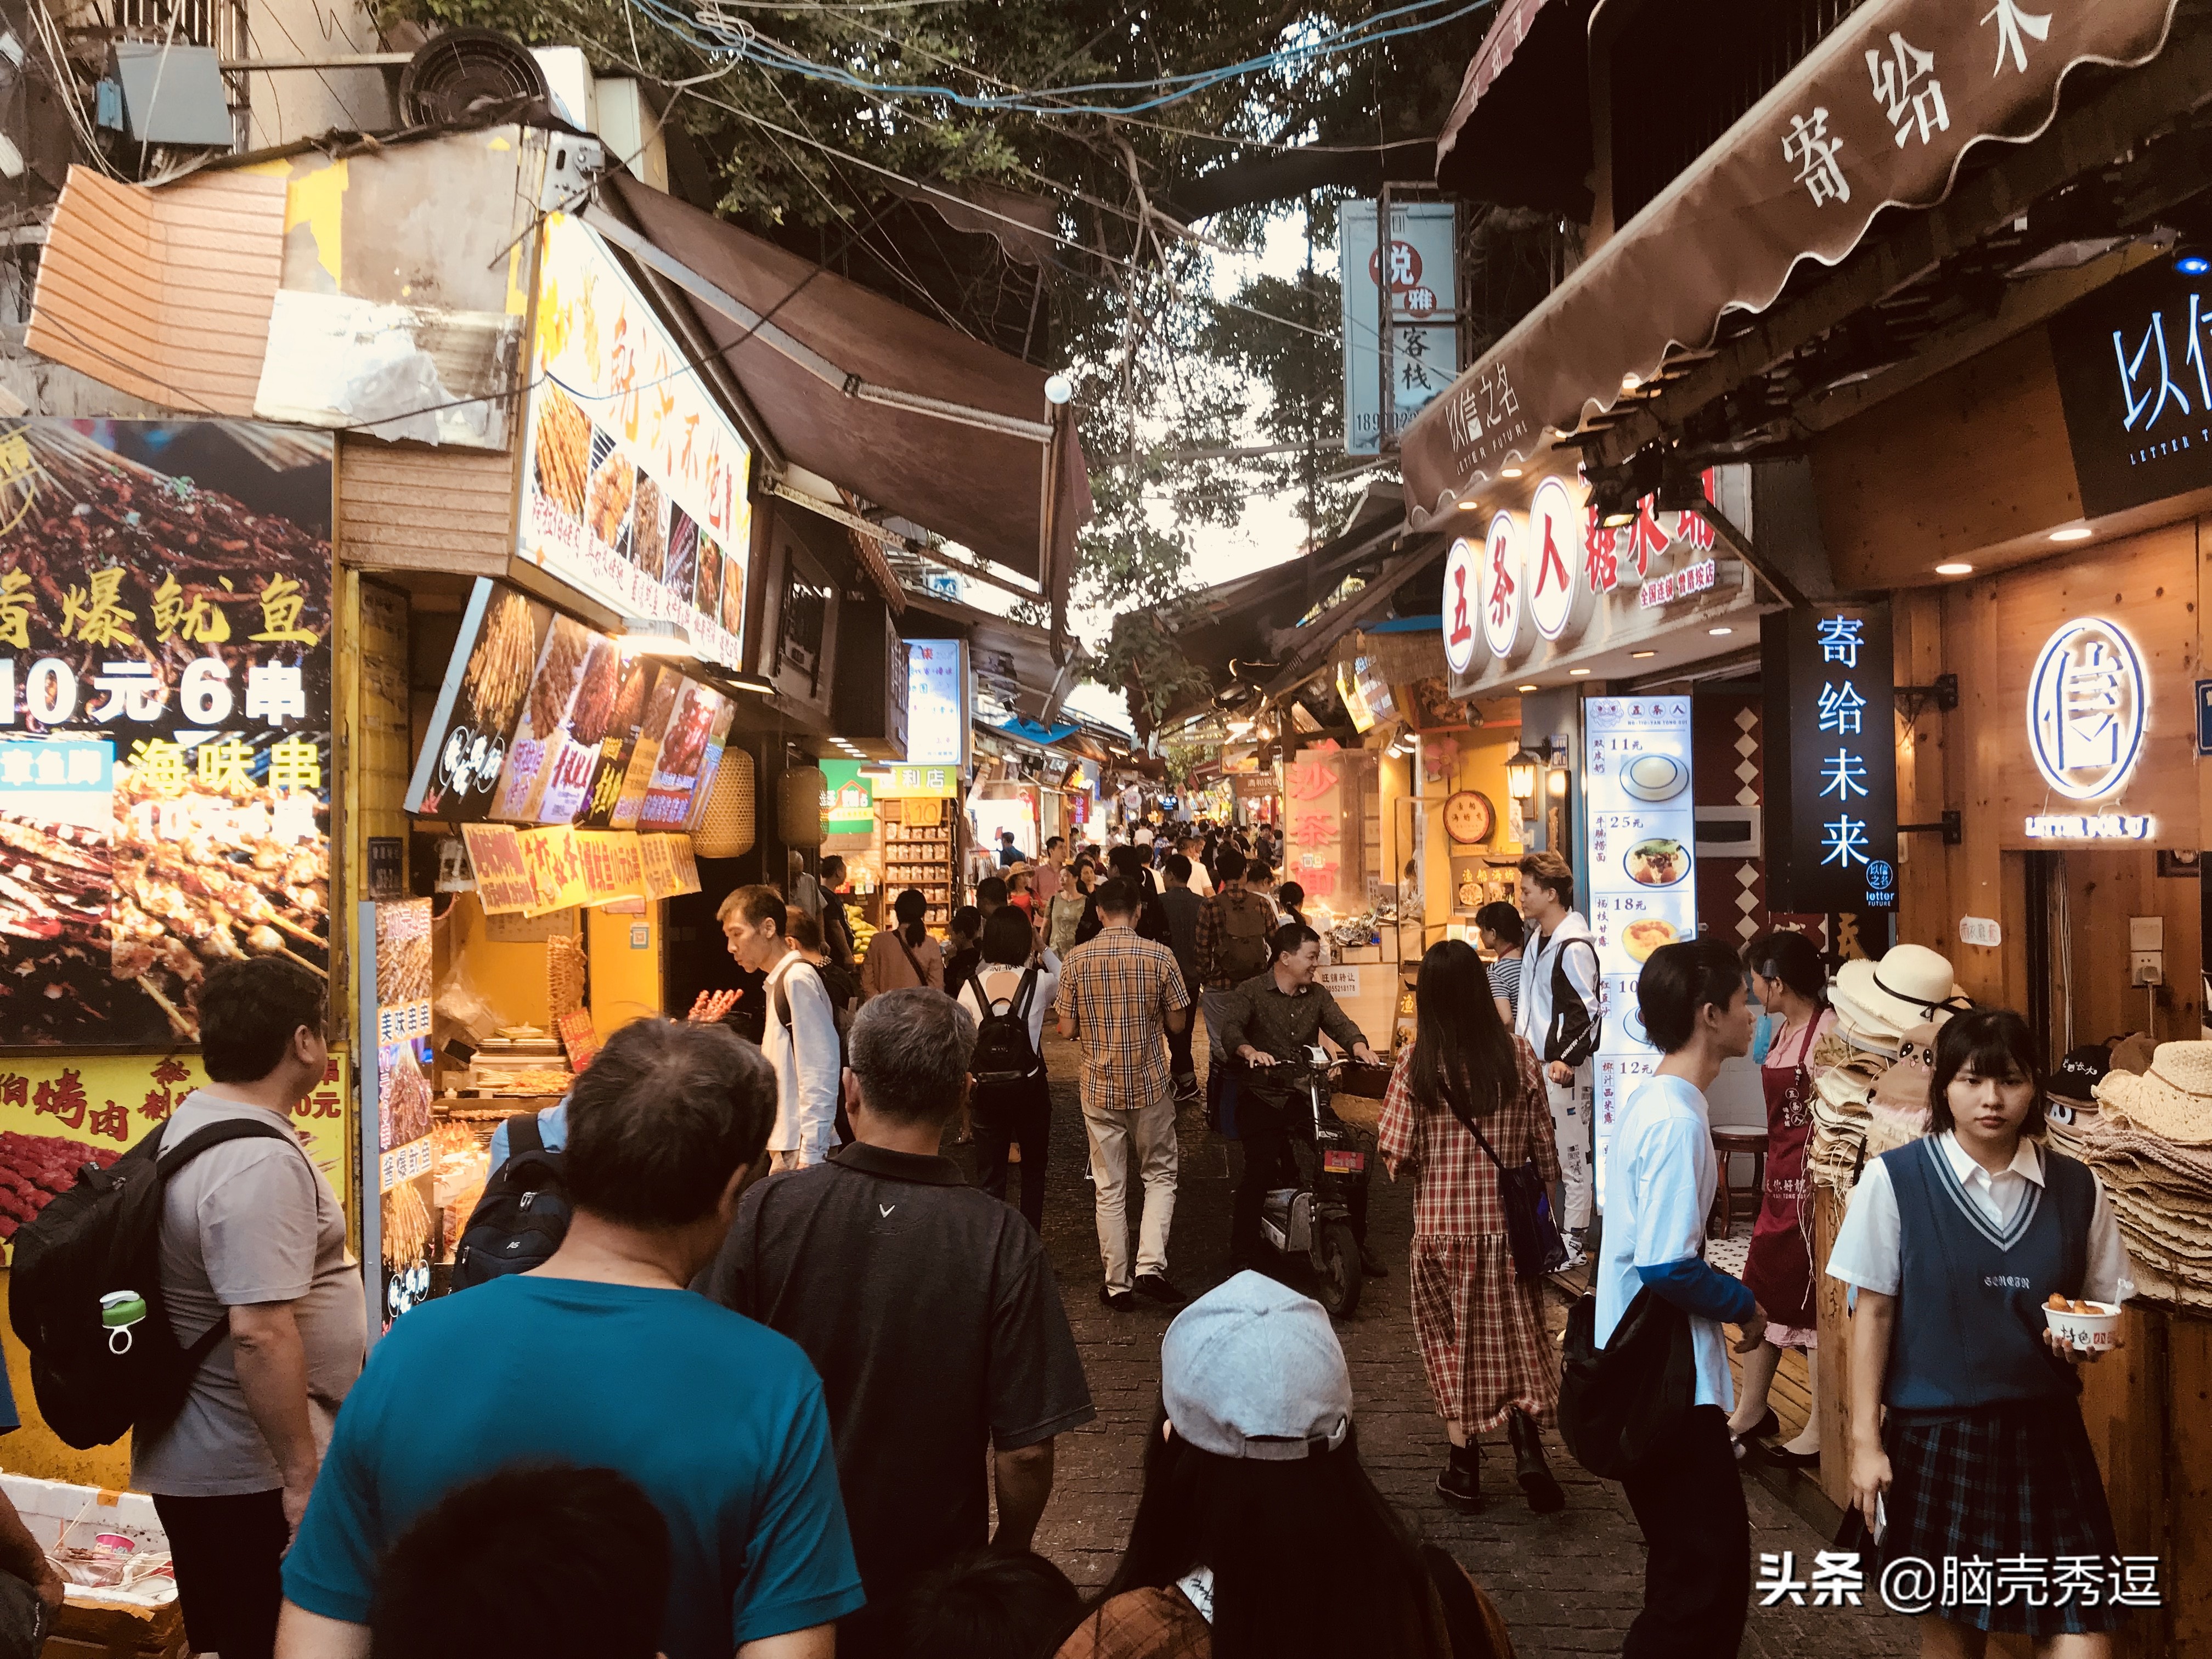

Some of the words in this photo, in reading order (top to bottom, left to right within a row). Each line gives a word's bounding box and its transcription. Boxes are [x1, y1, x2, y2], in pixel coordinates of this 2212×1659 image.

[1401, 327, 1431, 390] 客栈
[1357, 413, 1419, 431] 18902
[1457, 447, 1486, 476] LETTER
[1492, 420, 1527, 452] FUTURE
[2130, 436, 2189, 465] LETTER
[1817, 614, 1870, 868] 寄给未来
[127, 738, 321, 795] 海味串
[915, 803, 938, 823] 10
[1610, 816, 1644, 828] 25元
[1613, 898, 1646, 911] 18元
[380, 1001, 430, 1043] 美味串串
[1620, 1062, 1653, 1075] 12元
